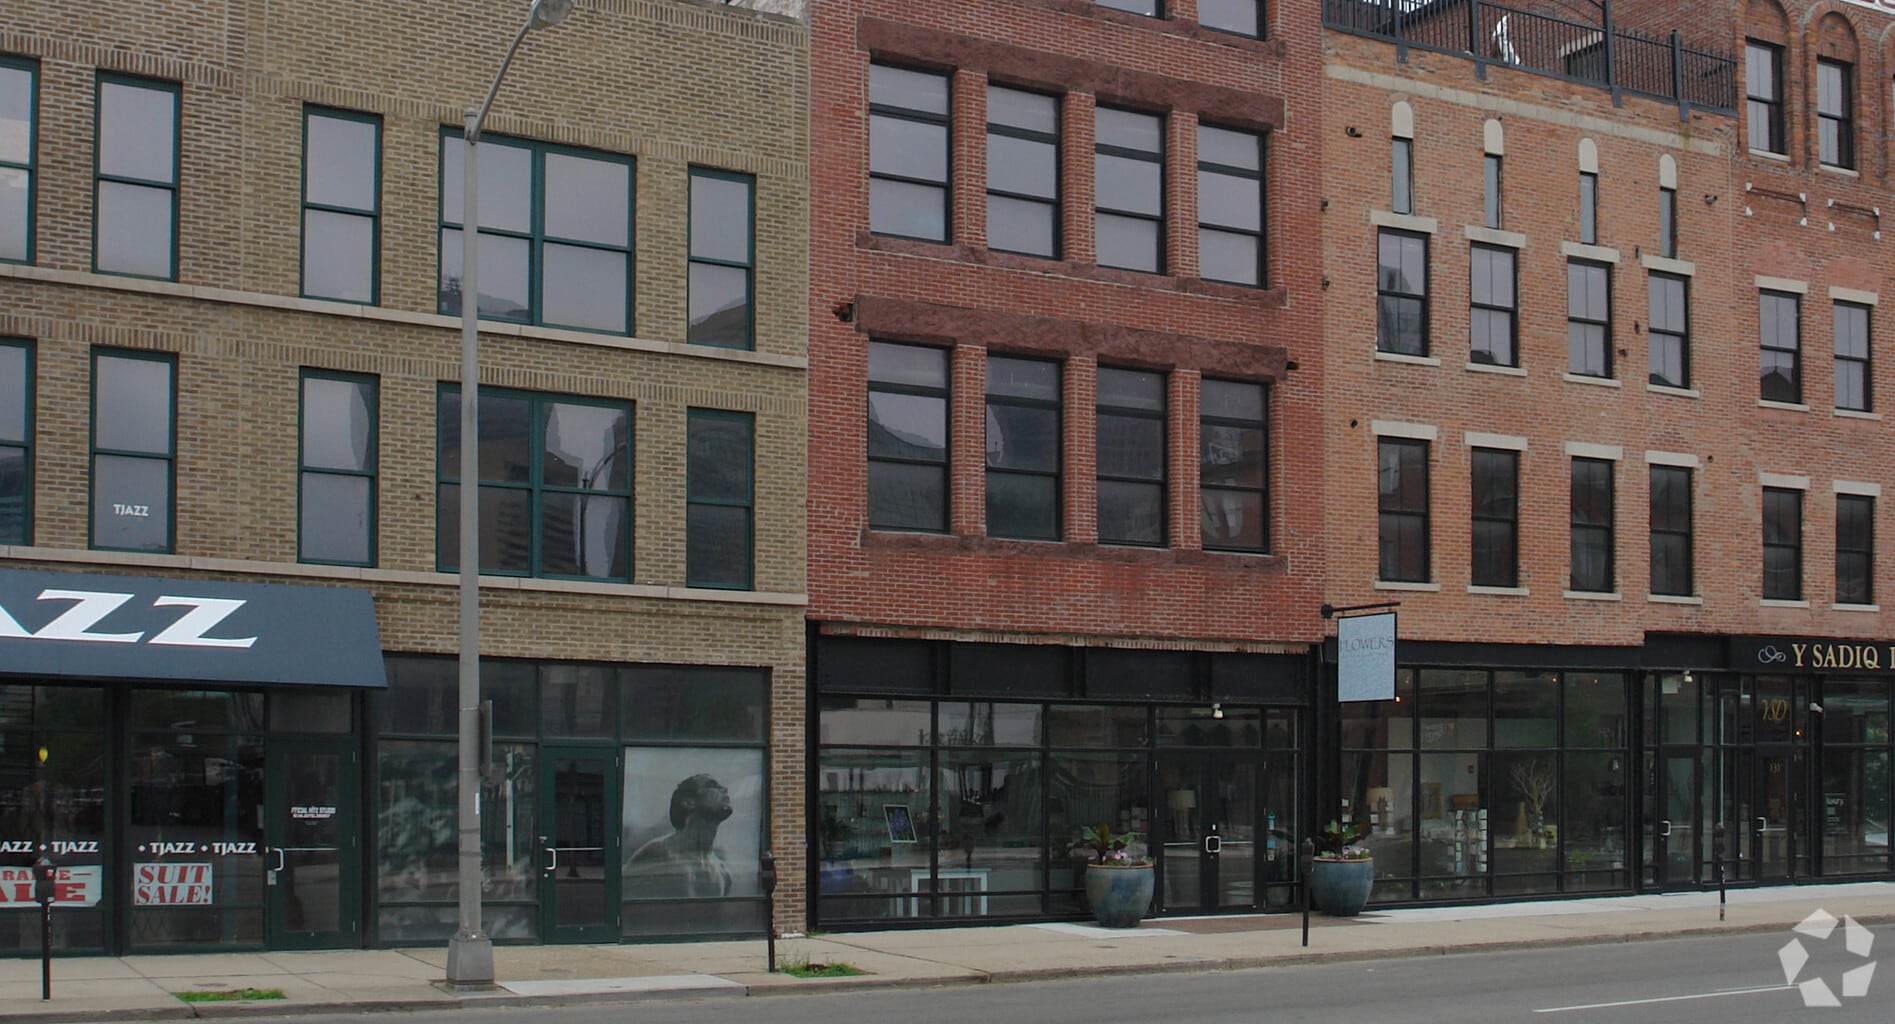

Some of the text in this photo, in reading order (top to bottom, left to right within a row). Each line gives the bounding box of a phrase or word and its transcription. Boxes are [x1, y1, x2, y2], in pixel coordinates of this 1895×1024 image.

[113, 503, 149, 517] TJAZZ
[1792, 643, 1807, 666] Y
[1812, 643, 1881, 669] SADIQ
[51, 841, 98, 856] TJAZZ
[150, 842, 257, 856] TJAZZ TJAZZ
[138, 865, 209, 884] SUIT
[136, 885, 211, 905] SALE!
